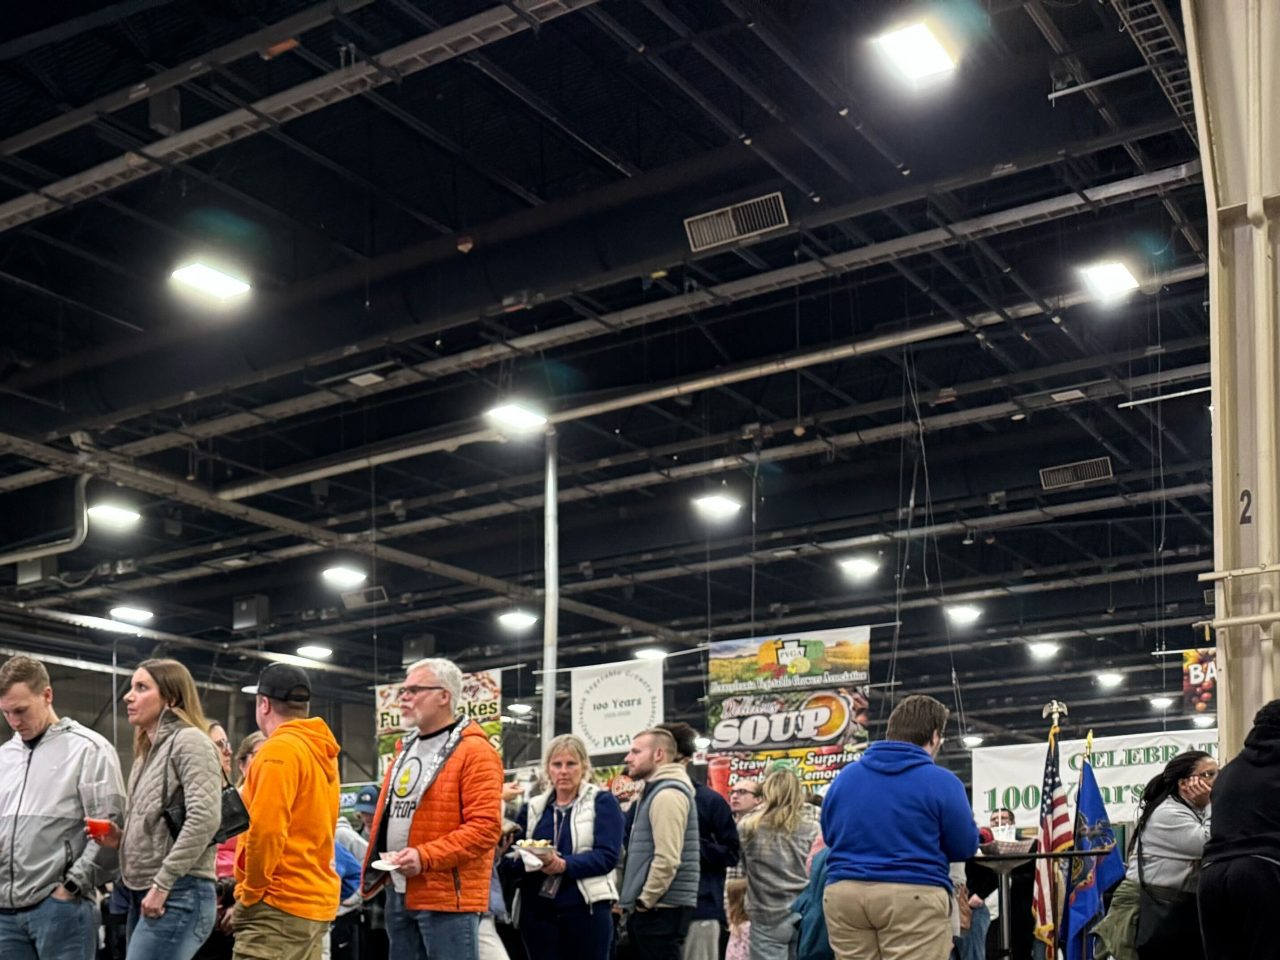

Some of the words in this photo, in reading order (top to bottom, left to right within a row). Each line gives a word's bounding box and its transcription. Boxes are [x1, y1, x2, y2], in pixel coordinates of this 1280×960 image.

[1240, 490, 1251, 525] 2
[456, 702, 497, 717] akes
[612, 698, 642, 709] Years
[711, 706, 831, 749] SOUP
[984, 785, 1040, 812] 100
